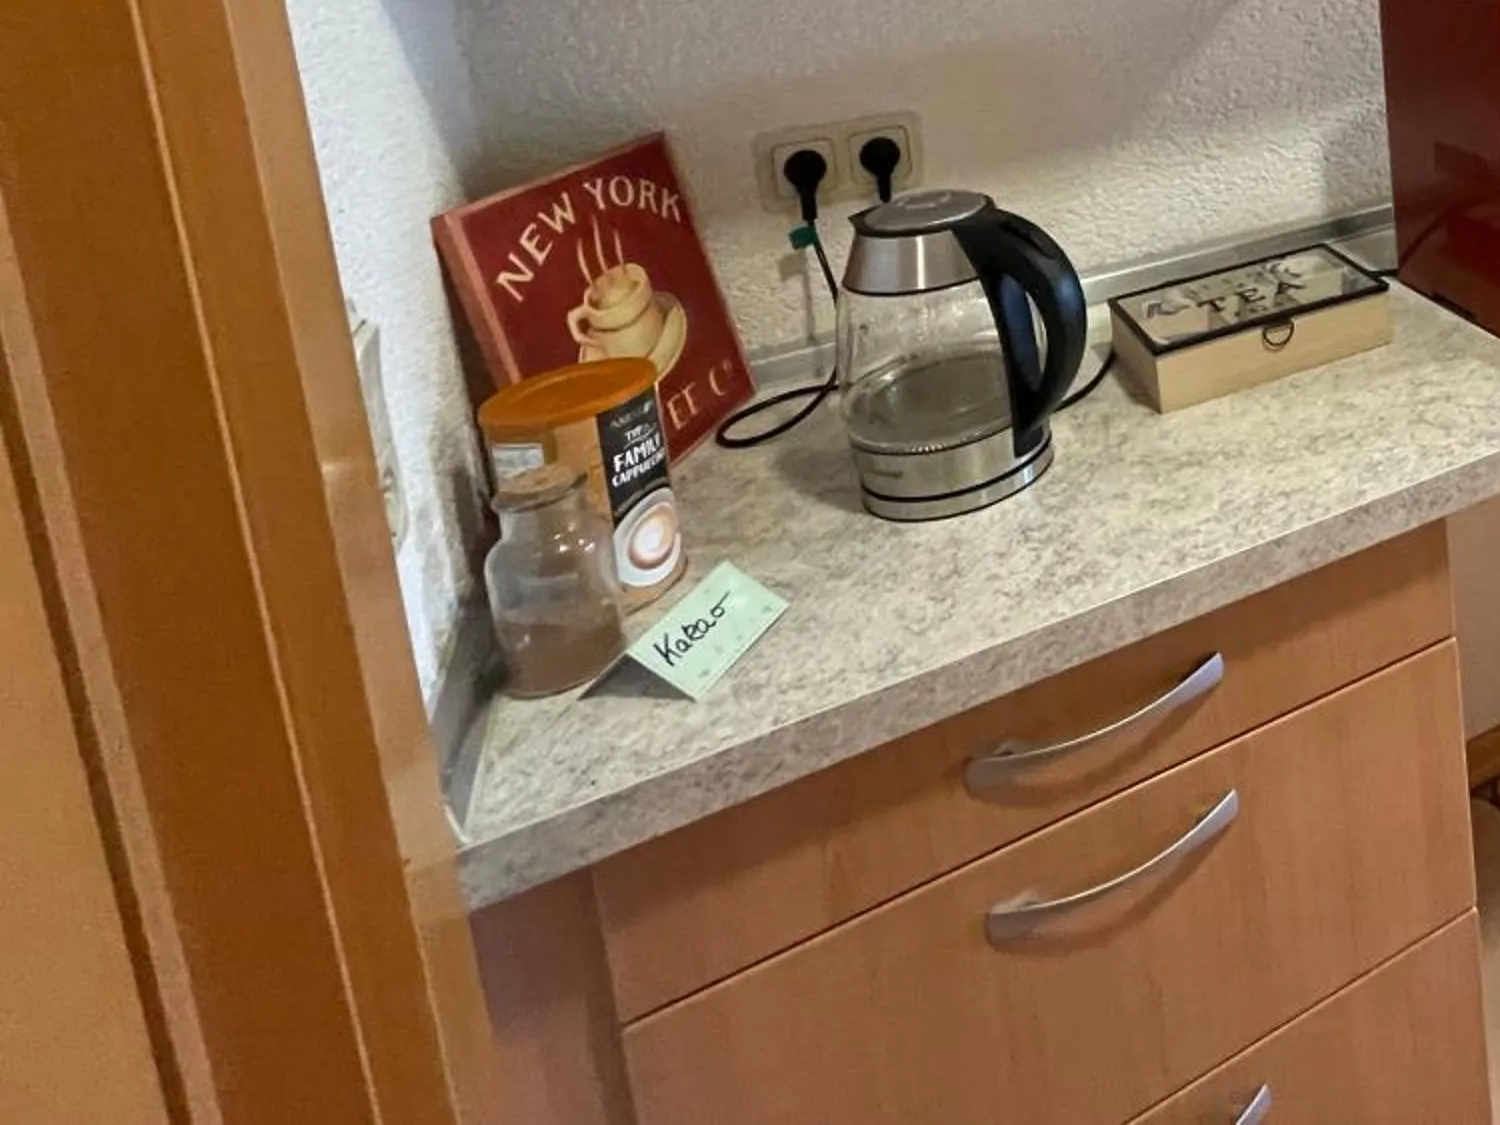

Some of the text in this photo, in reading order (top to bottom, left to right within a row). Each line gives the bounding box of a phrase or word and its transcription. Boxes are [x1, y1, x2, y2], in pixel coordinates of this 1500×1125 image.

[496, 175, 682, 303] NEW YORK
[1197, 279, 1307, 313] TEA
[652, 589, 731, 667] Kakao
